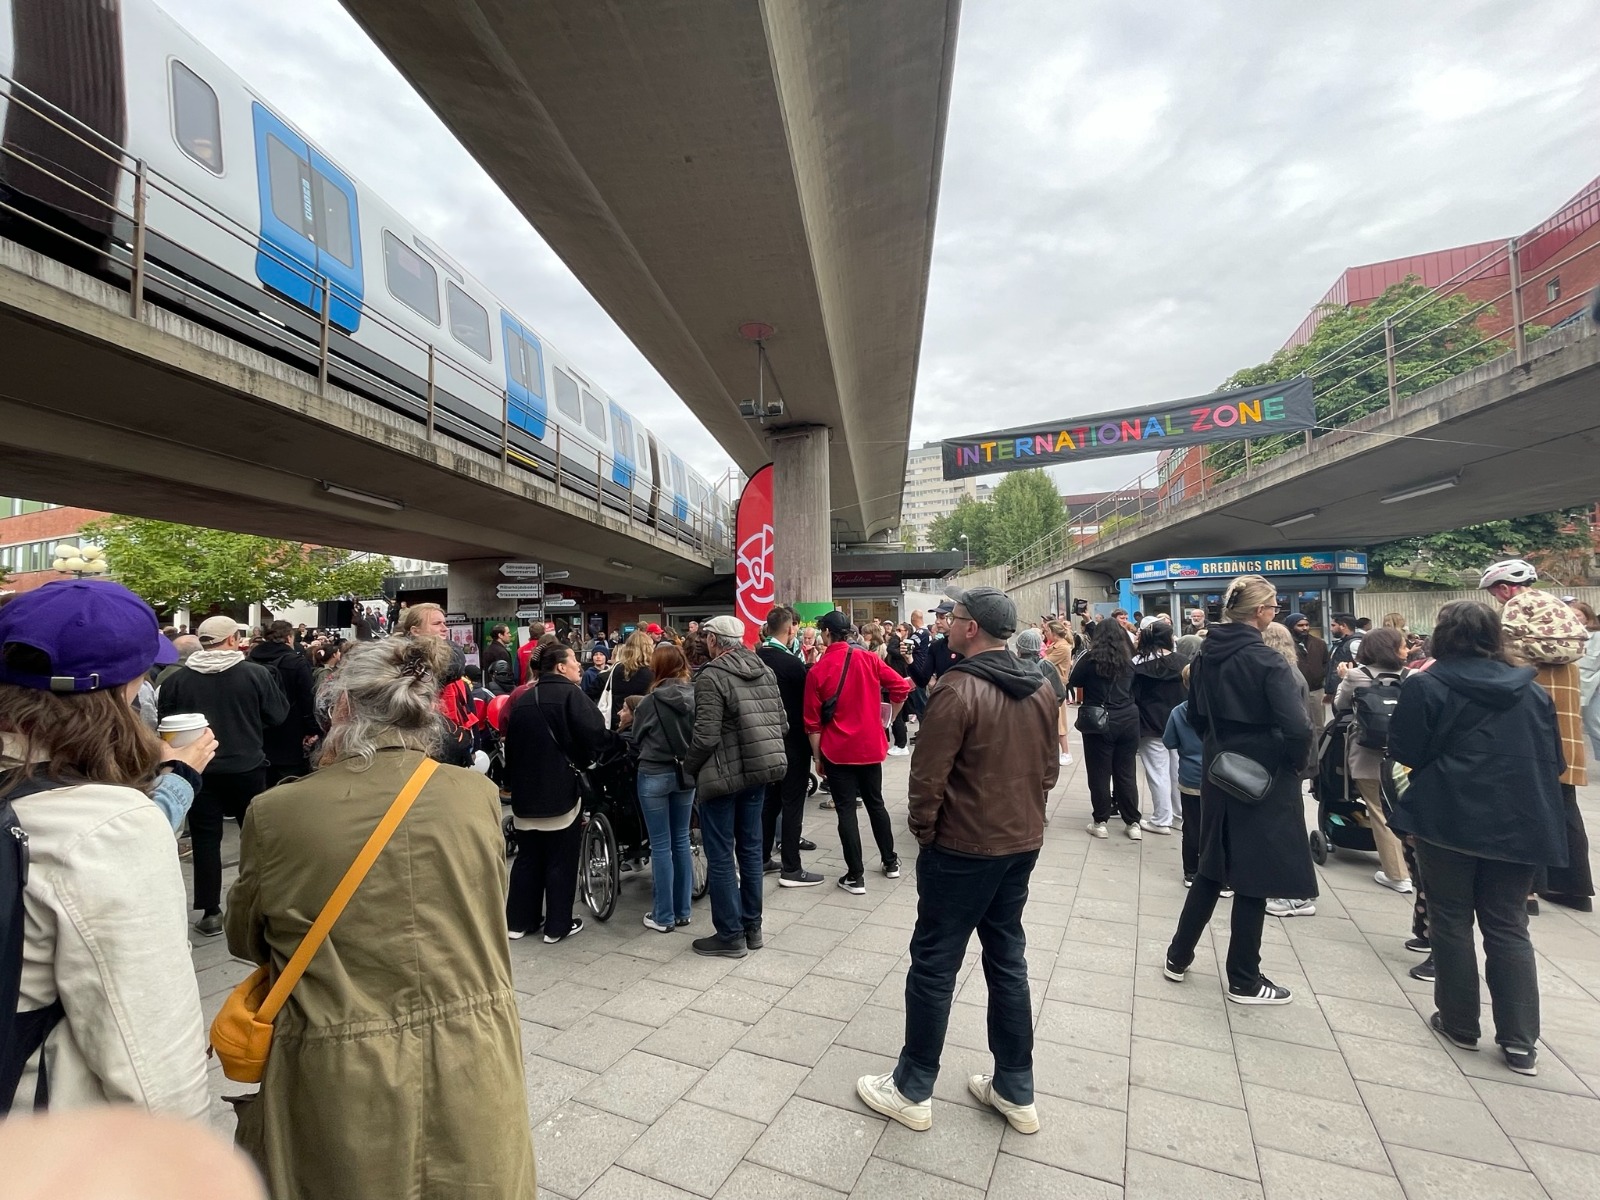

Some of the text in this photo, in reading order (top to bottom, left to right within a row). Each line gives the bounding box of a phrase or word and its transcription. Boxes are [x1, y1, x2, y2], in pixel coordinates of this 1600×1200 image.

[957, 396, 1286, 466] INTERNATIONAL ZONE
[1202, 560, 1262, 574] BREDÄNGS
[1265, 558, 1298, 571] GRILL
